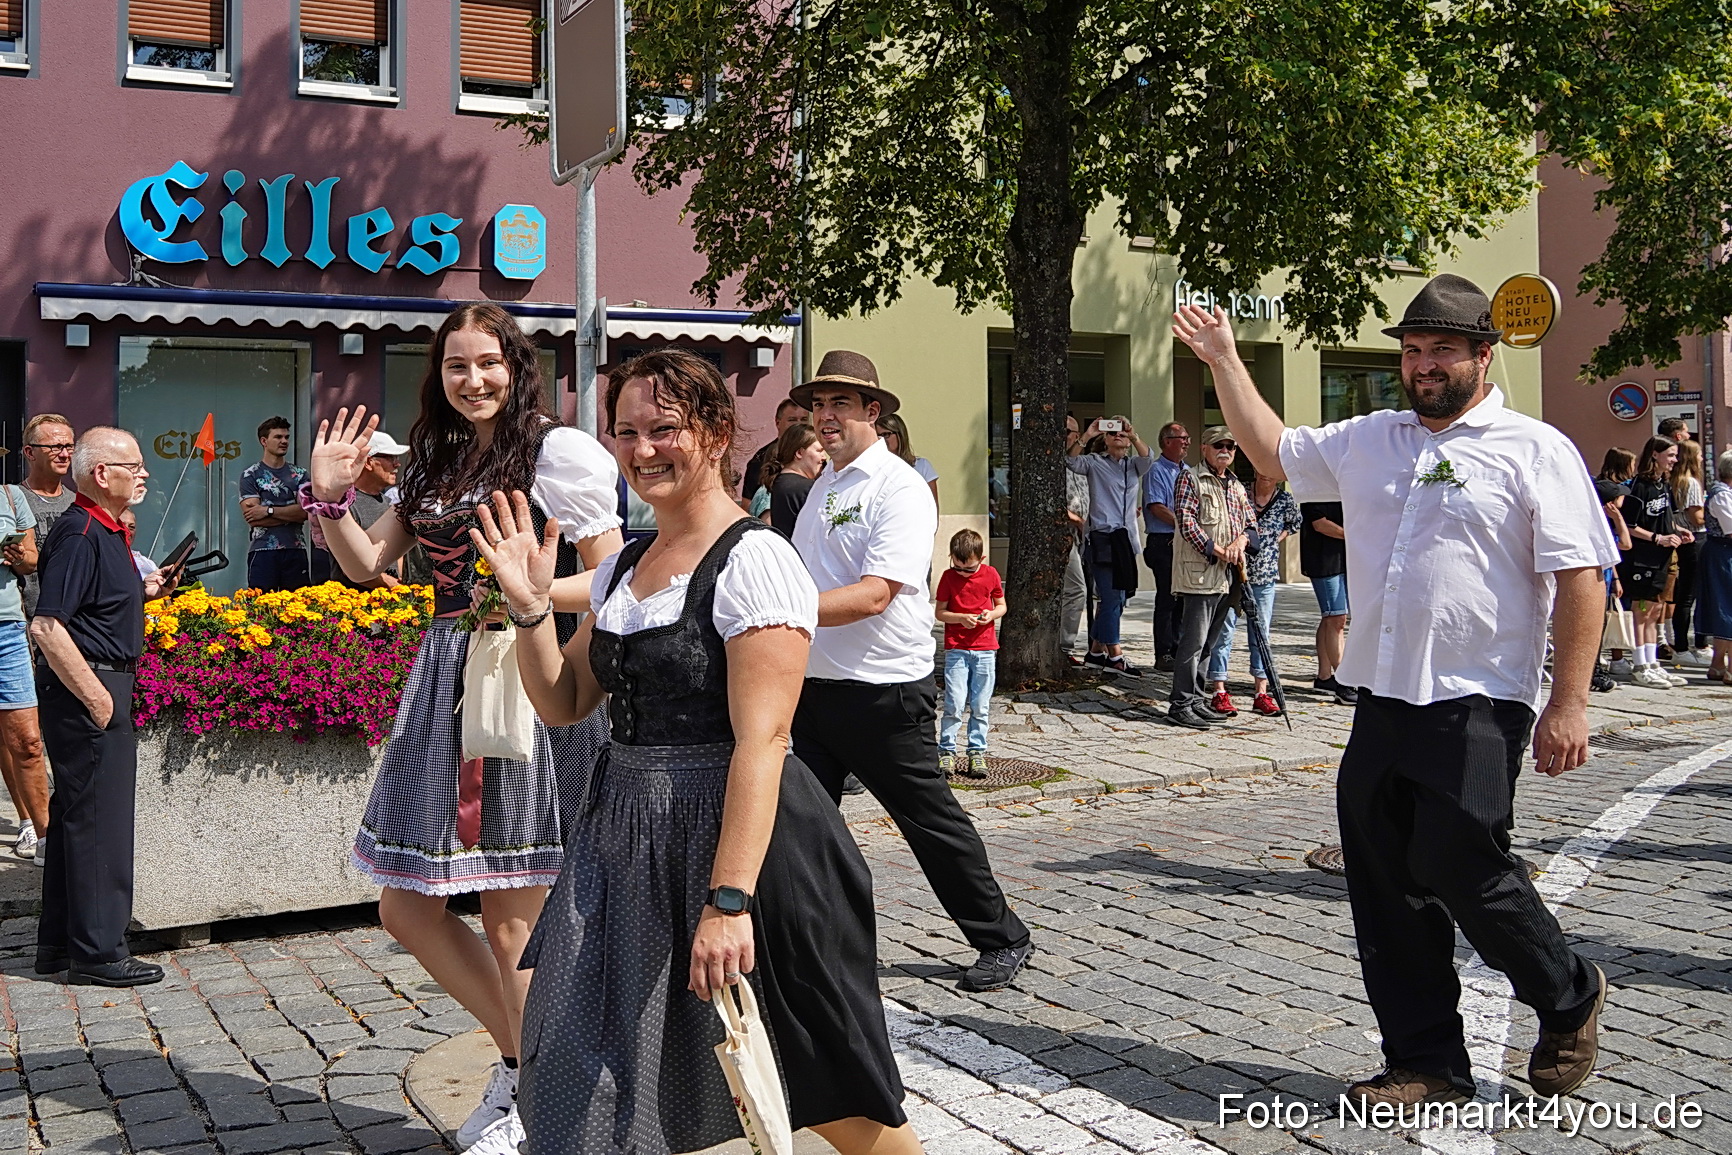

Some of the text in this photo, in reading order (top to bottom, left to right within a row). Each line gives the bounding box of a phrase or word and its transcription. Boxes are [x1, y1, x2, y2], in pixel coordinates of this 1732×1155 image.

[119, 160, 464, 276] Eilles
[1505, 288, 1526, 296] STADT
[1505, 294, 1547, 307] HOTEL
[1505, 307, 1531, 318] NEU
[1505, 316, 1547, 329] MARKT
[153, 429, 242, 460] Eiles
